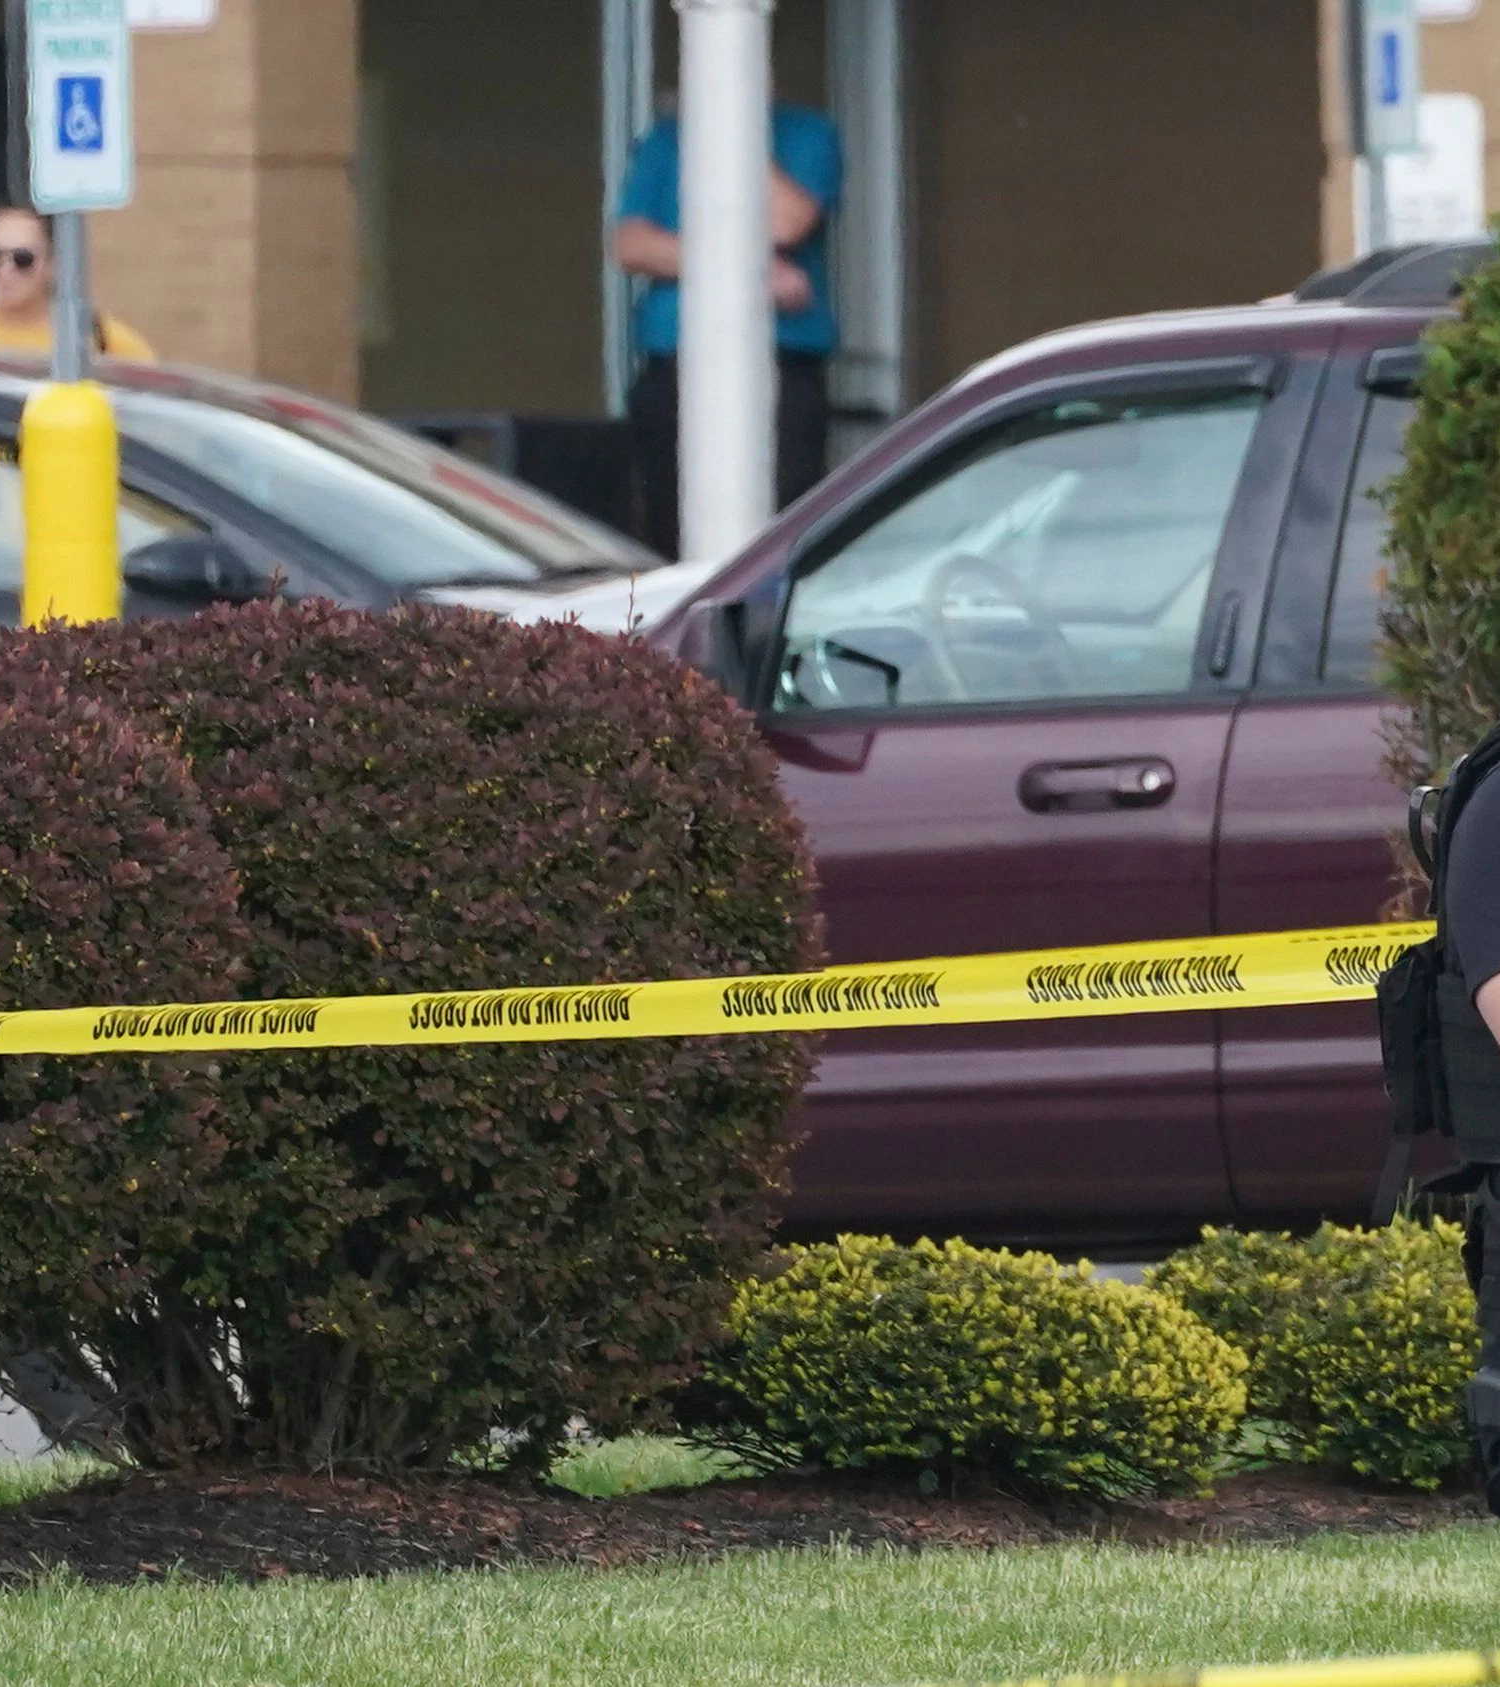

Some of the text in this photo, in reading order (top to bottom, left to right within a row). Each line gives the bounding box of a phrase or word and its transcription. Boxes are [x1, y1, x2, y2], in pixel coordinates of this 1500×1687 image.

[1027, 954, 1245, 1003] POLICE LINE DO NOT CROSS
[1326, 945, 1381, 985] CROSS
[409, 989, 640, 1029] POLICE LINE DO NOT CROSS
[722, 972, 945, 1017] POLICE LINE DO NOT CROSS
[259, 1005, 323, 1034] POLICE
